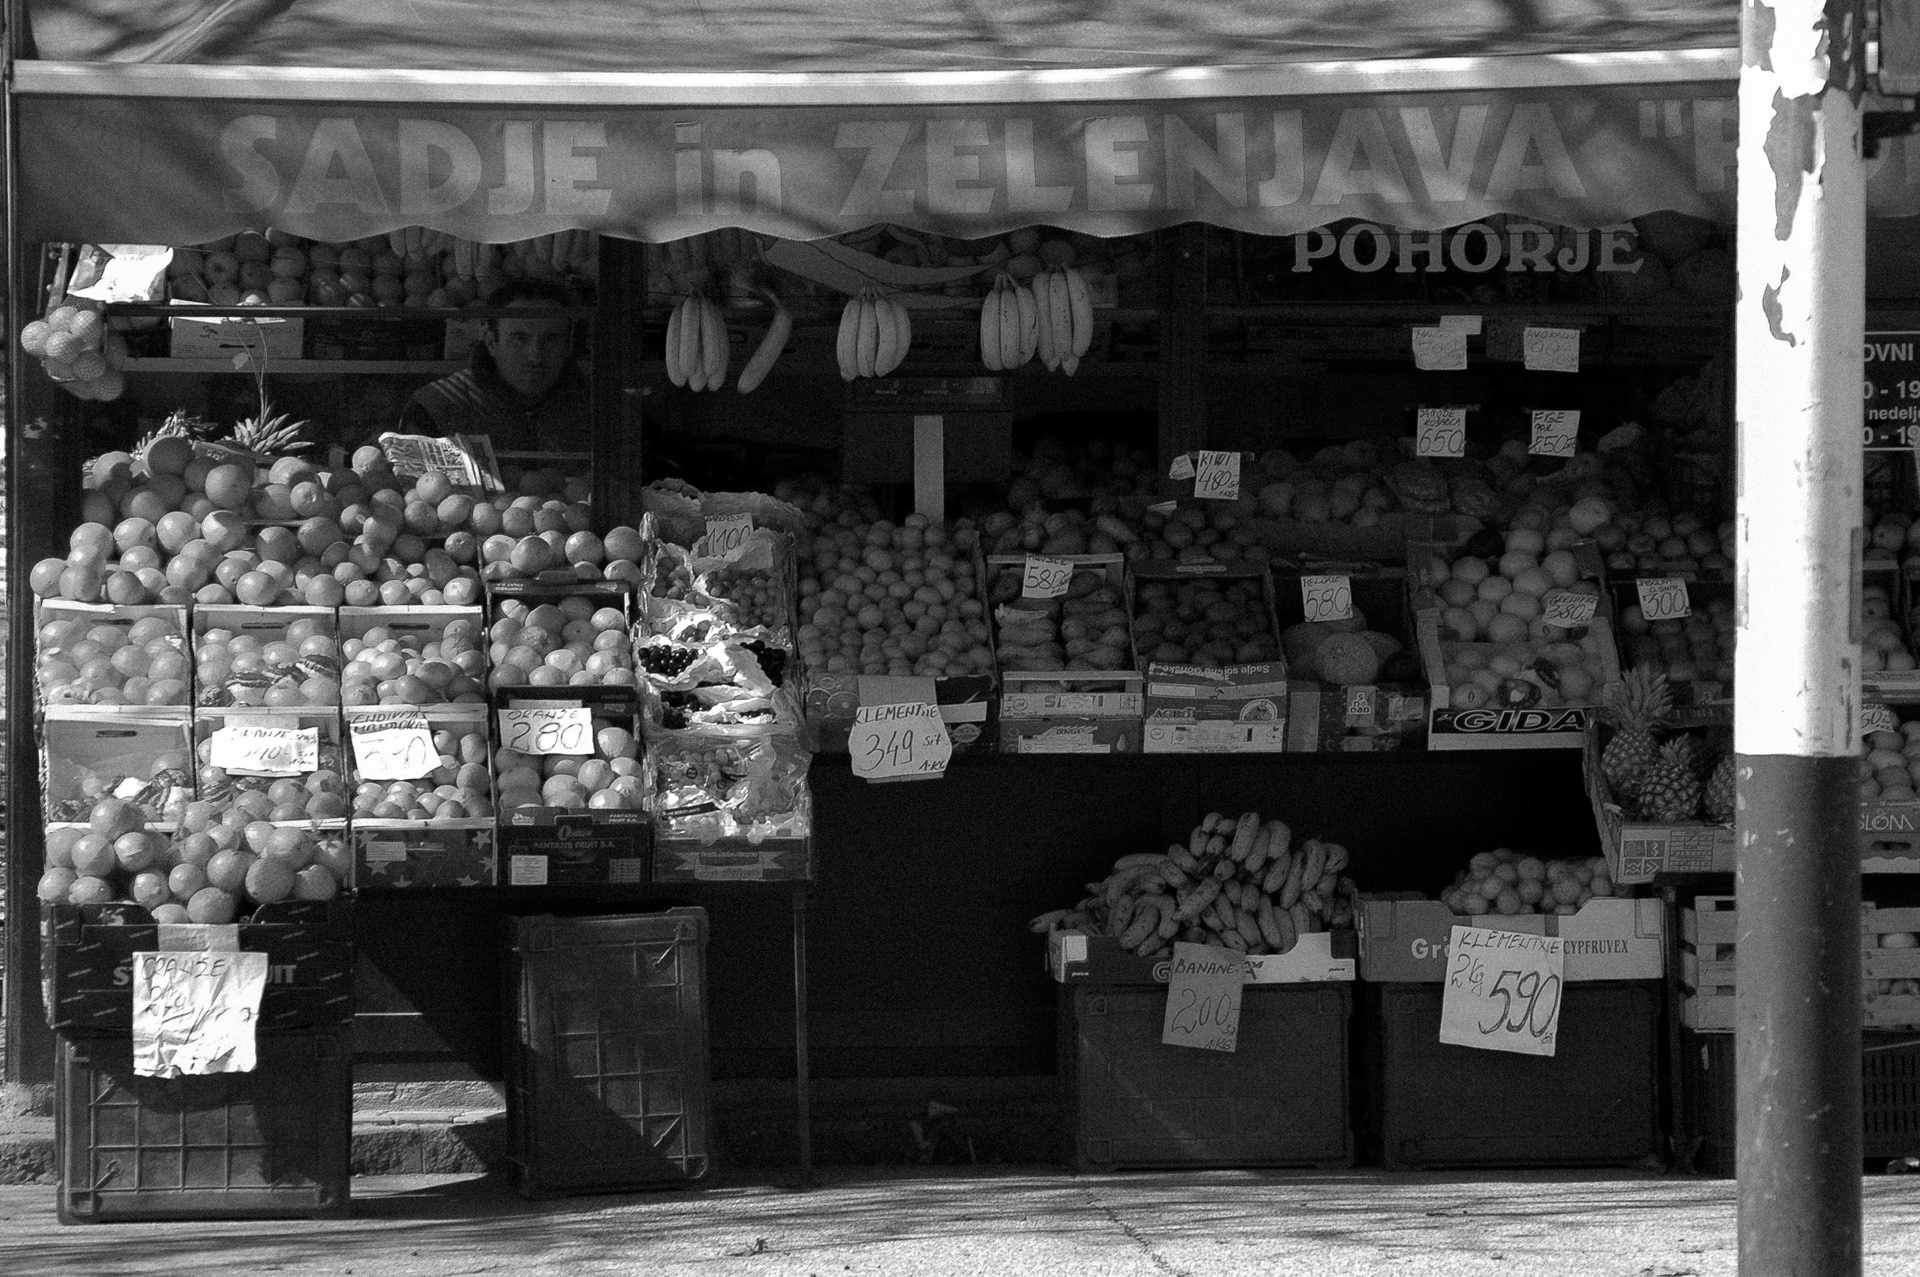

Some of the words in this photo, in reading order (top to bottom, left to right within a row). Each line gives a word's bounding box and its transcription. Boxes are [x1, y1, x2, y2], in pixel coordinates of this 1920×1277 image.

[219, 114, 612, 216] SADJE
[673, 120, 782, 215] in
[833, 103, 1587, 216] ZELENJAVA
[1291, 221, 1644, 275] POHORJE
[1862, 342, 1914, 362] OVNI
[1869, 406, 1920, 423] nedelj
[1419, 428, 1464, 454] 650
[1199, 452, 1231, 467] KIWI
[1198, 464, 1232, 491] 480
[1305, 586, 1350, 621] 580
[1642, 588, 1686, 618] 300
[1454, 708, 1587, 732] GIDA
[509, 722, 584, 752] 280
[859, 729, 914, 772] 349
[1173, 958, 1236, 975] BANANE
[1478, 970, 1561, 1038] 590
